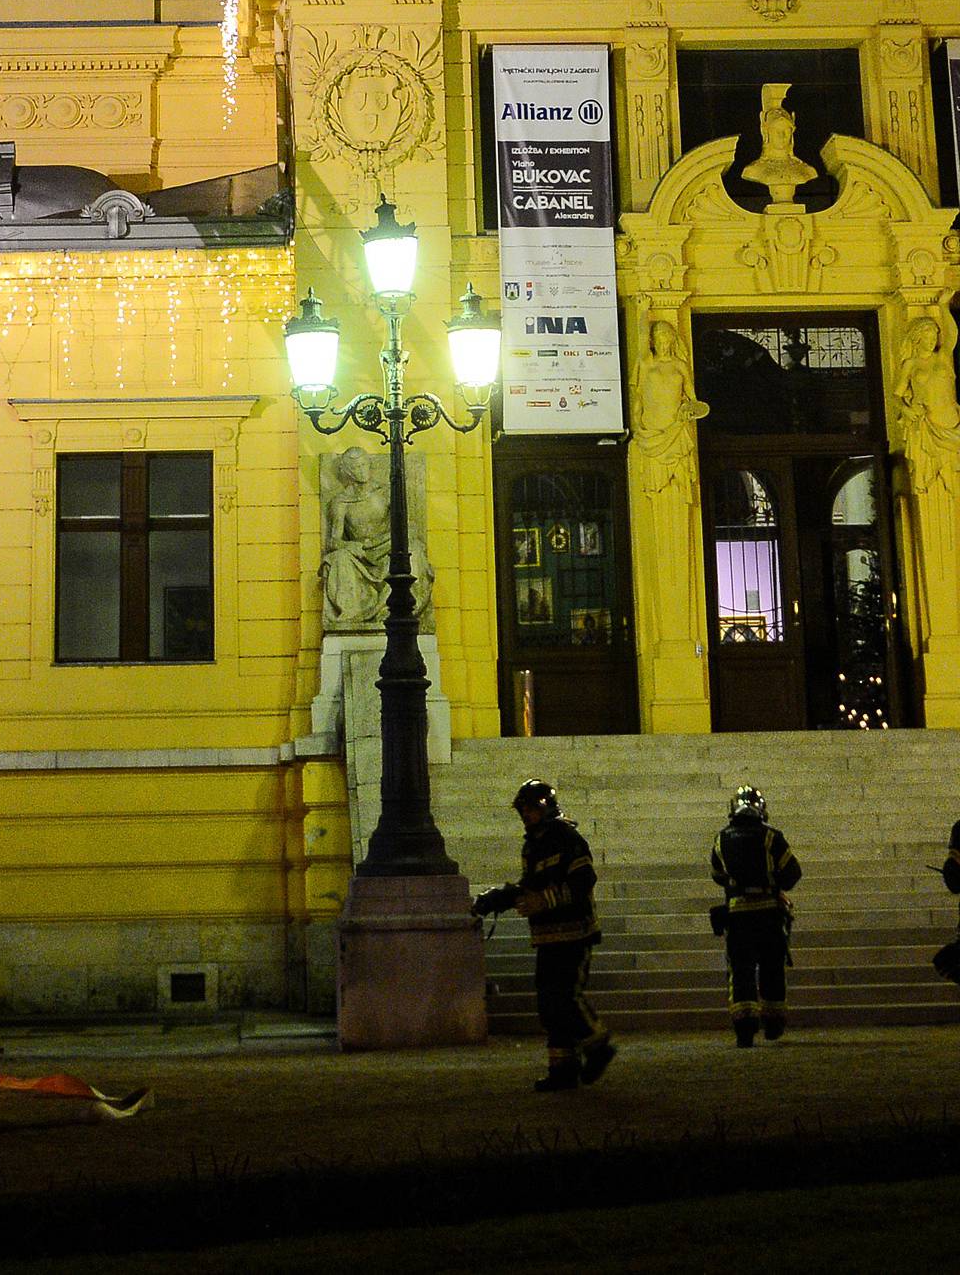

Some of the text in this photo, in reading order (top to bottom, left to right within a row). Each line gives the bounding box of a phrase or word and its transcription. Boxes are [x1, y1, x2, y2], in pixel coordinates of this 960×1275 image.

[501, 103, 573, 121] Allianz
[511, 145, 543, 155] IZLOŽBA
[549, 147, 590, 155] EXHIBITION
[512, 169, 591, 184] BUKOVAC
[513, 196, 594, 210] CABANEL
[554, 212, 594, 220] Alexandre
